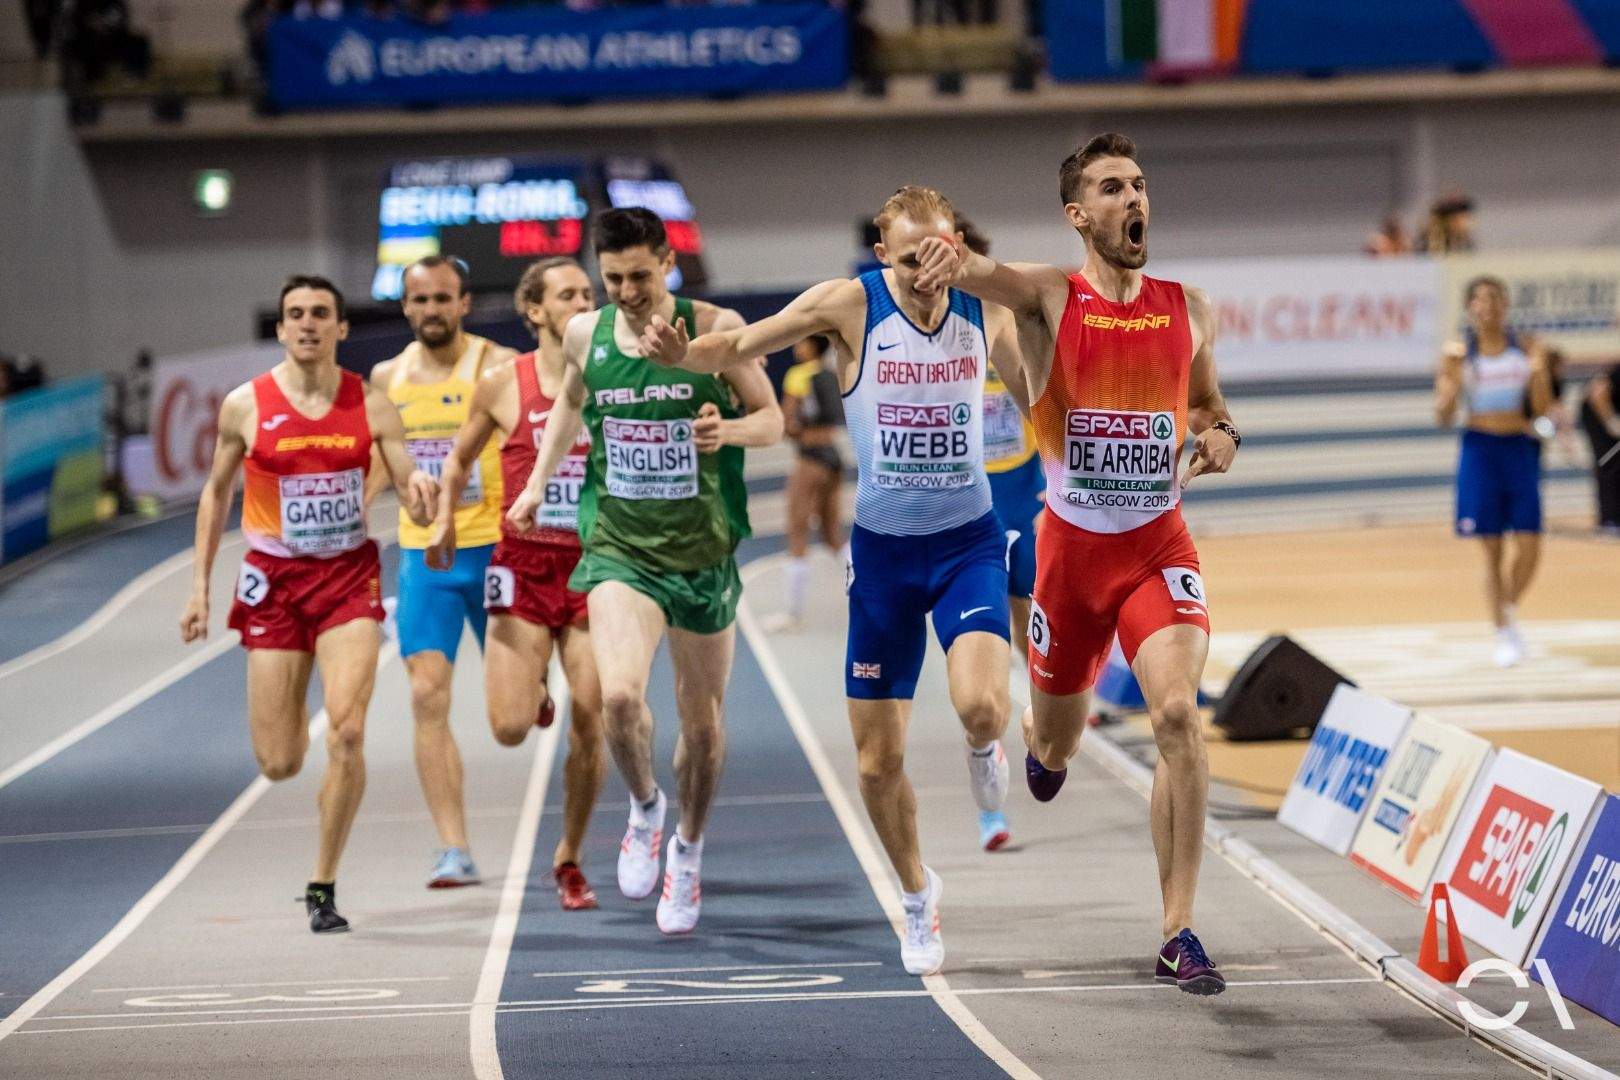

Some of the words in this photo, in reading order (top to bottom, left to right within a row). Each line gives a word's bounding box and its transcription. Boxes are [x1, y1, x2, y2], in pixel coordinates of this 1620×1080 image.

[380, 34, 589, 77] EUROPEAN
[596, 26, 798, 69] ATHLETICS
[1083, 313, 1171, 332] ESPAÑA
[877, 361, 924, 385] GREAT
[927, 356, 977, 384] BRITAIN
[879, 406, 949, 426] SPAR
[1069, 415, 1149, 435] SPAR
[275, 433, 357, 452] ESPAÑA
[604, 421, 667, 443] SPAR
[880, 430, 968, 459] WEBB
[610, 444, 692, 472] ENGLISH
[900, 464, 922, 473] RUN
[923, 463, 953, 473] CLEAN
[1069, 441, 1096, 472] DE
[1101, 442, 1171, 475] ARRIBA
[282, 478, 347, 497] SPAR
[877, 474, 942, 487] GLASGOW
[1094, 480, 1115, 490] RUN
[1118, 481, 1152, 491] CLEAN
[286, 498, 361, 524] GARCIA
[1067, 490, 1140, 508] GLASGOW
[1143, 494, 1170, 508] 2019
[244, 574, 260, 600] 2
[486, 575, 501, 600] 3
[1031, 611, 1044, 645] 6
[1468, 805, 1544, 902] SPAR
[1564, 853, 1620, 951] EURO
